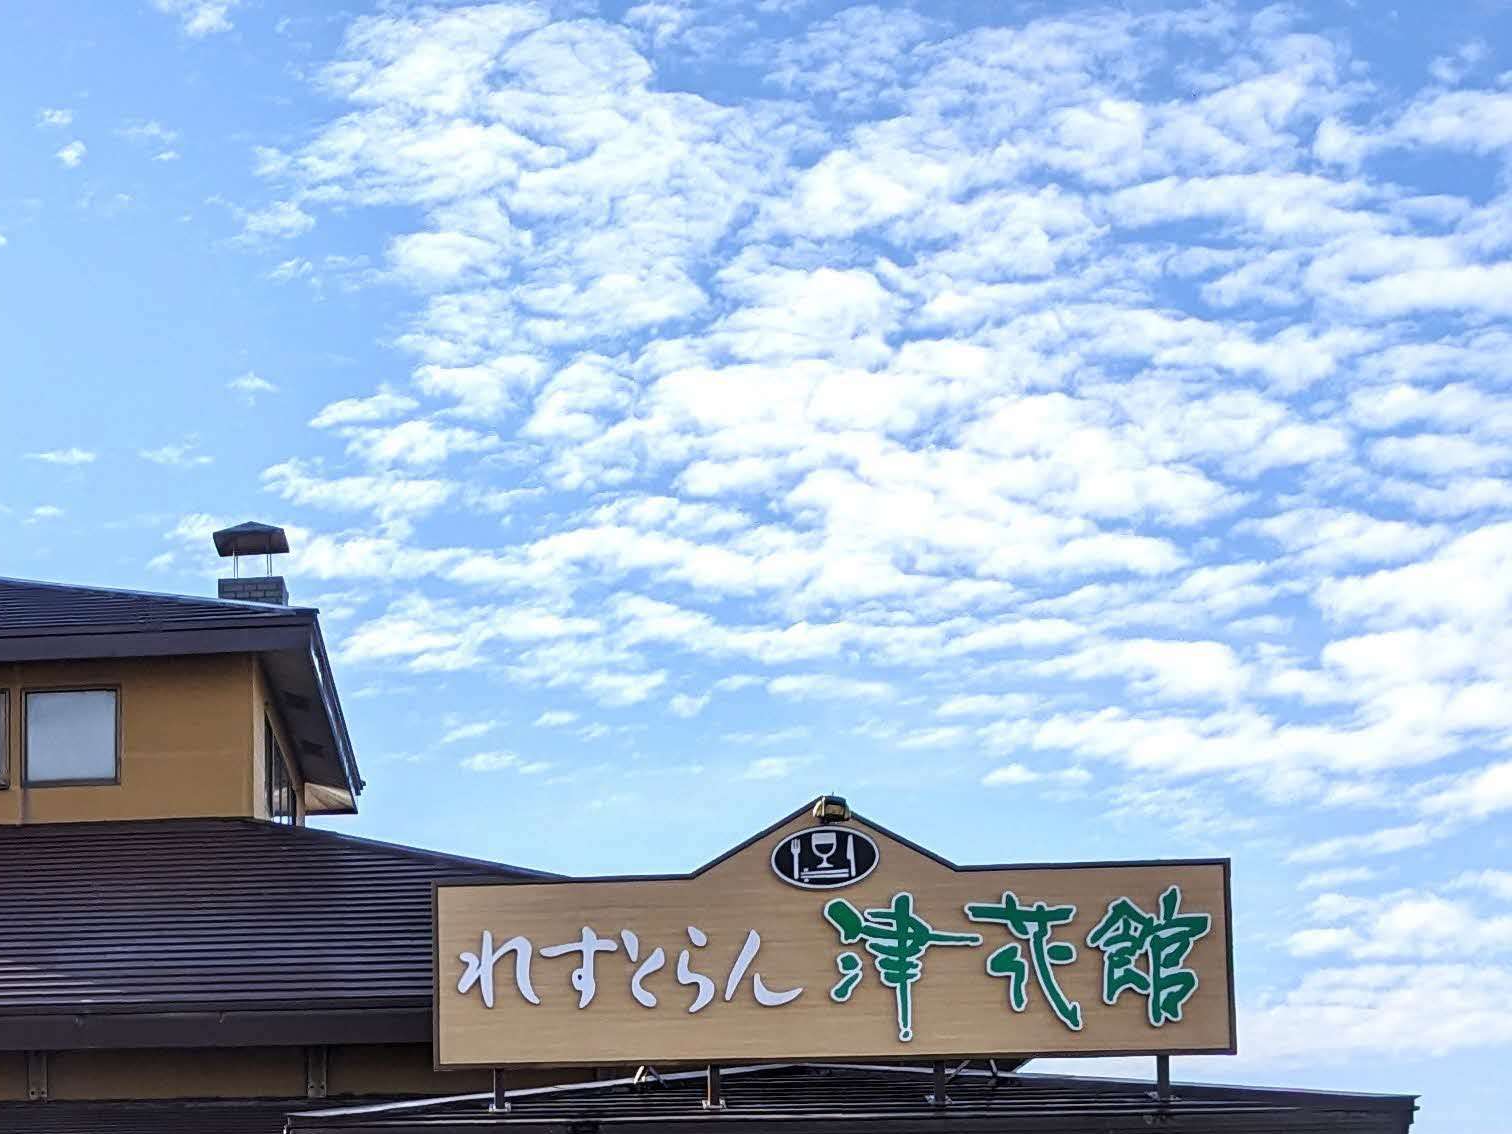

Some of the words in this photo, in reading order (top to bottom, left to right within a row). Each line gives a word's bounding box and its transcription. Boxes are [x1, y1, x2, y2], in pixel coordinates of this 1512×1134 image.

[458, 926, 803, 1013] れすとらん
[823, 885, 1212, 1042] 津花館
